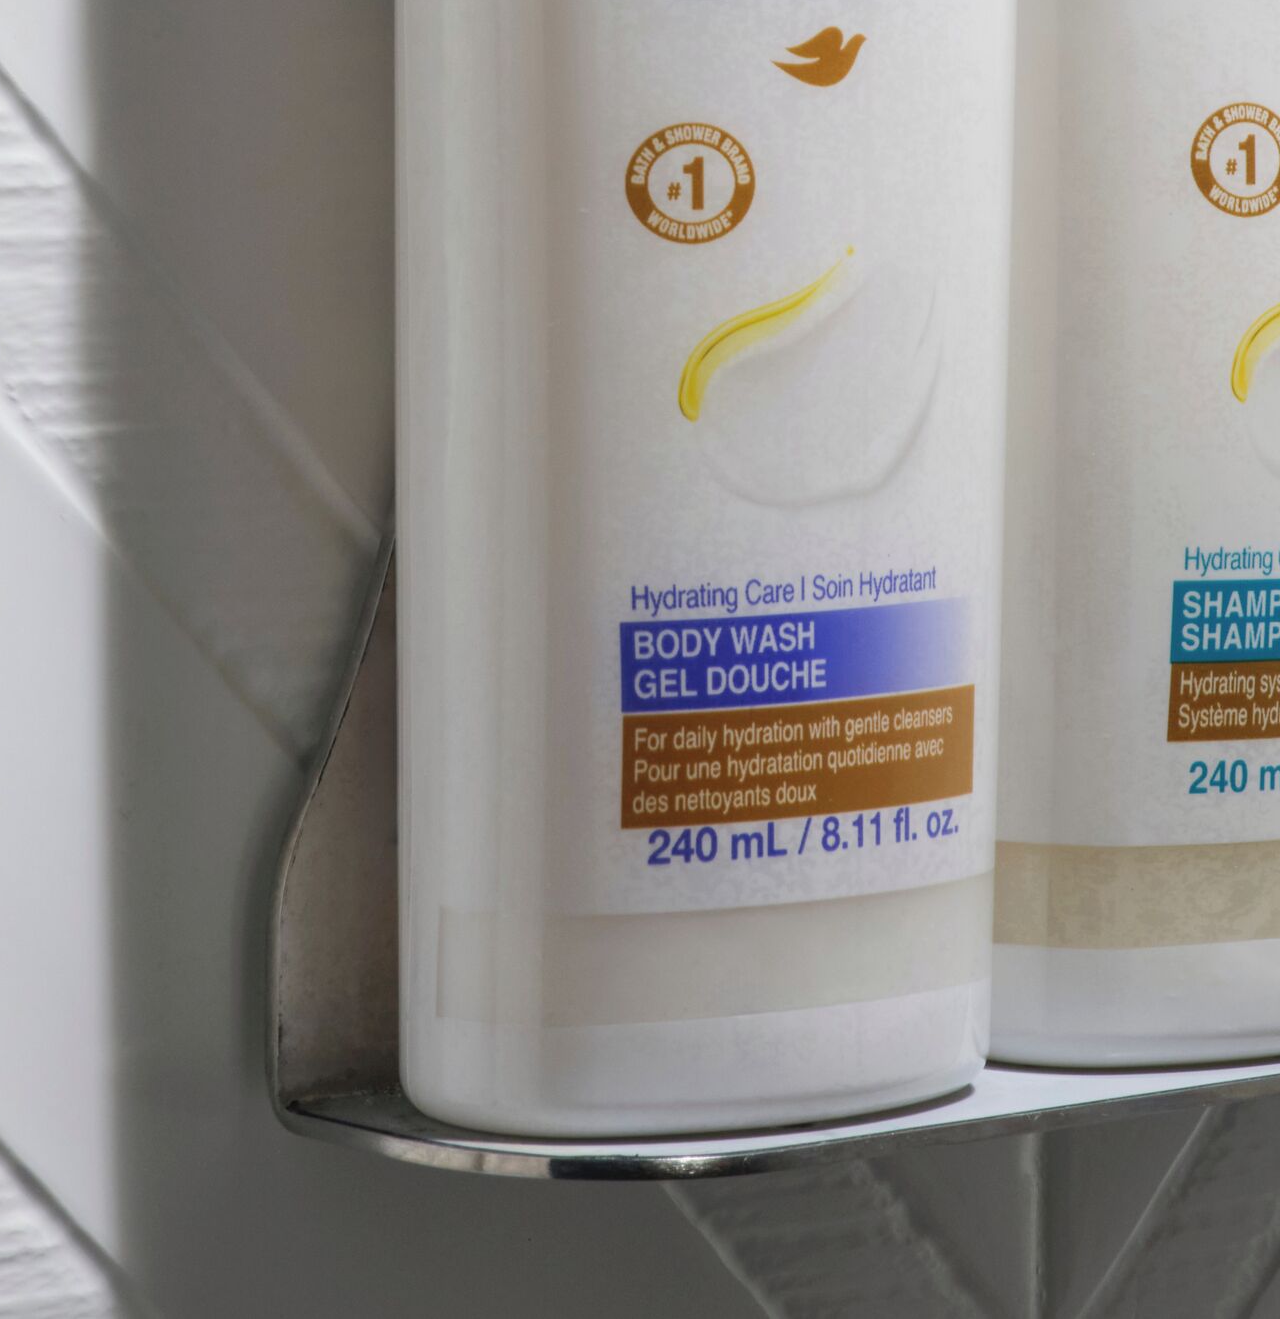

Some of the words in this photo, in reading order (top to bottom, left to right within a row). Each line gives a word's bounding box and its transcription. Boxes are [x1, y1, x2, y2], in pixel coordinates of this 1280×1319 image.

[1195, 125, 1215, 161] BATH
[1224, 105, 1269, 124] SHOWER
[631, 147, 655, 184] BATH
[652, 138, 665, 151] &
[665, 125, 721, 146] SHOWER
[720, 138, 750, 184] BRAND
[1184, 546, 1272, 576] Hydrating
[631, 585, 738, 616] Hydrating
[745, 579, 794, 605] Care
[812, 573, 853, 600] Soin
[859, 567, 936, 602] Hydratant
[634, 628, 721, 659] BODY
[730, 621, 815, 654] WASH
[634, 669, 697, 698] GEL
[707, 659, 827, 696] DOUCHE
[1180, 671, 1255, 701] Hydrating
[635, 727, 666, 751] For
[673, 726, 717, 754] daily
[723, 720, 803, 754] hydration
[809, 716, 839, 738] with
[845, 711, 889, 741] gentle
[893, 704, 953, 731] cleansers
[1178, 704, 1247, 732] Système
[634, 760, 679, 782] Pour
[686, 759, 721, 779] une
[727, 751, 821, 781] hydratation
[827, 741, 911, 774] quotidienne
[915, 738, 944, 758] avec
[1189, 759, 1248, 794] 240
[633, 791, 668, 814] des
[675, 785, 770, 814] nettoyants
[776, 783, 816, 806] doux
[647, 827, 717, 865] 240
[731, 823, 787, 860] mL
[798, 818, 811, 854] /
[822, 812, 881, 852] 8.11
[894, 807, 917, 843] fl.
[927, 809, 958, 838] oz.
